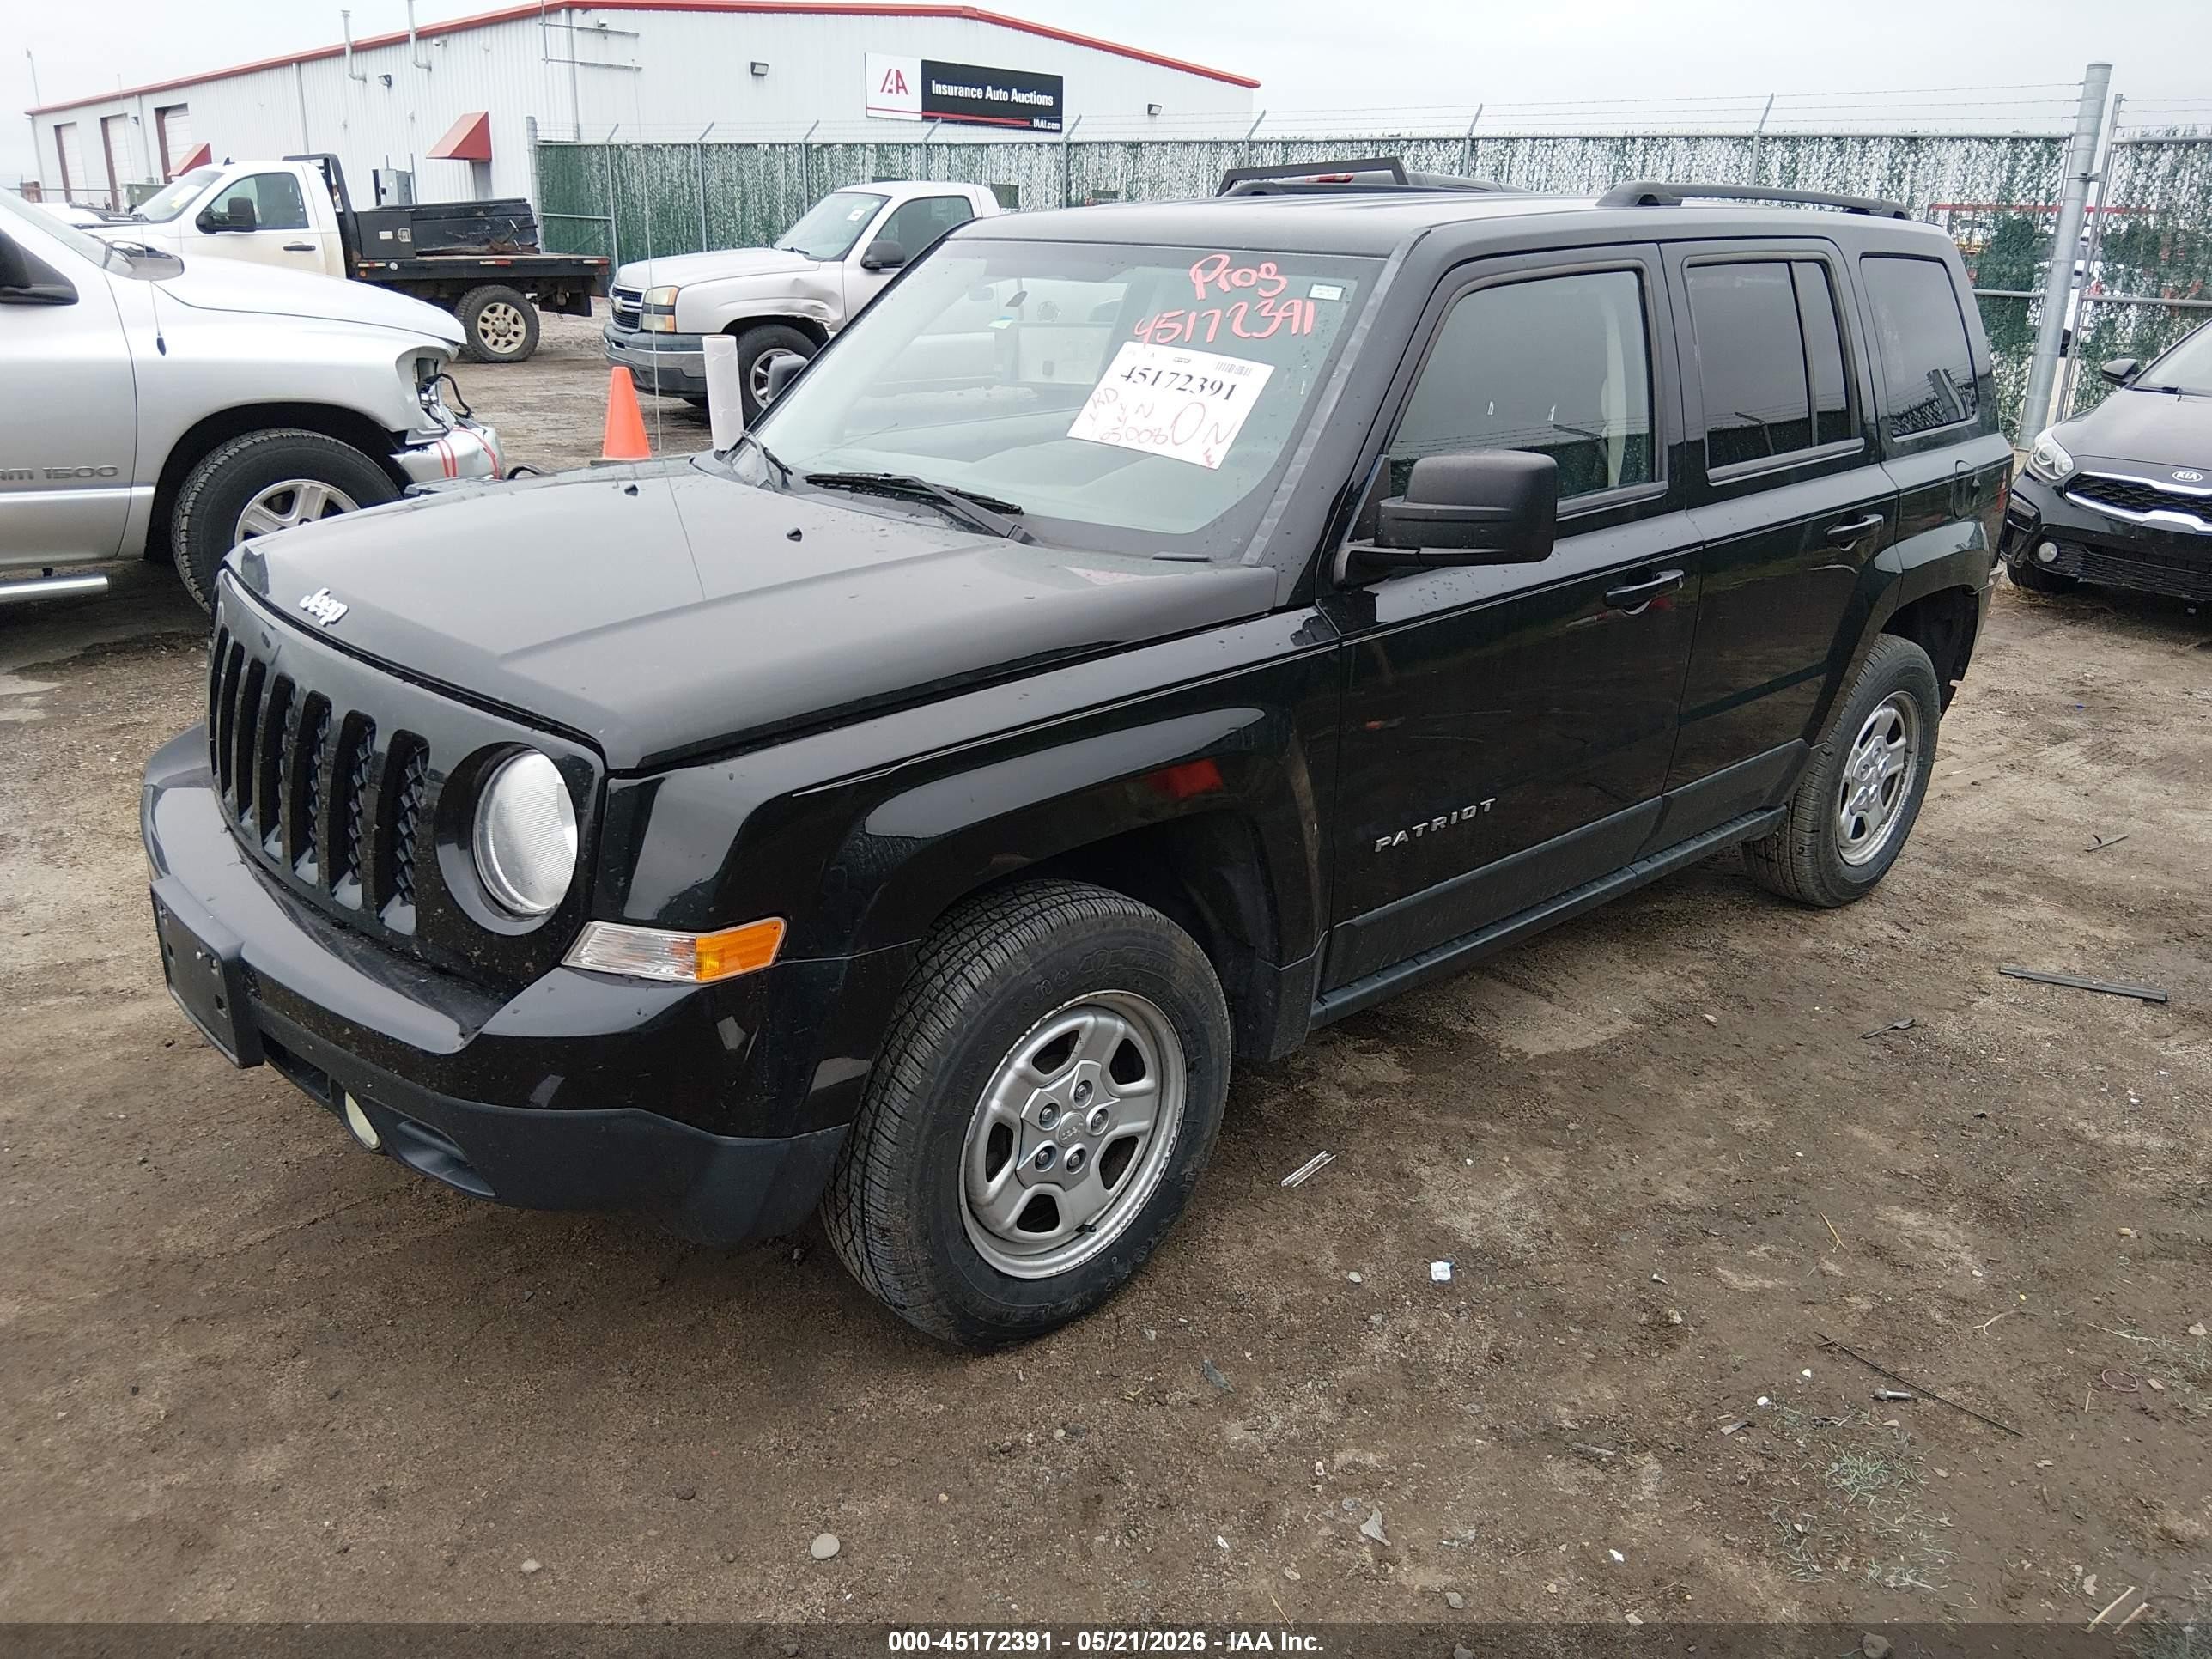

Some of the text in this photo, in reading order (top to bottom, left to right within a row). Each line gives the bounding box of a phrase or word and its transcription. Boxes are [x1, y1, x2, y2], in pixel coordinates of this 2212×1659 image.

[932, 79, 1054, 106] Insurance Auto Auctions
[1033, 119, 1060, 131] IAAI.com
[1120, 365, 1237, 401] 45172391
[42, 465, 118, 479] 1500
[2175, 471, 2198, 481] KIA
[299, 587, 349, 626] Jeep
[1374, 798, 1497, 853] PATRIOT
